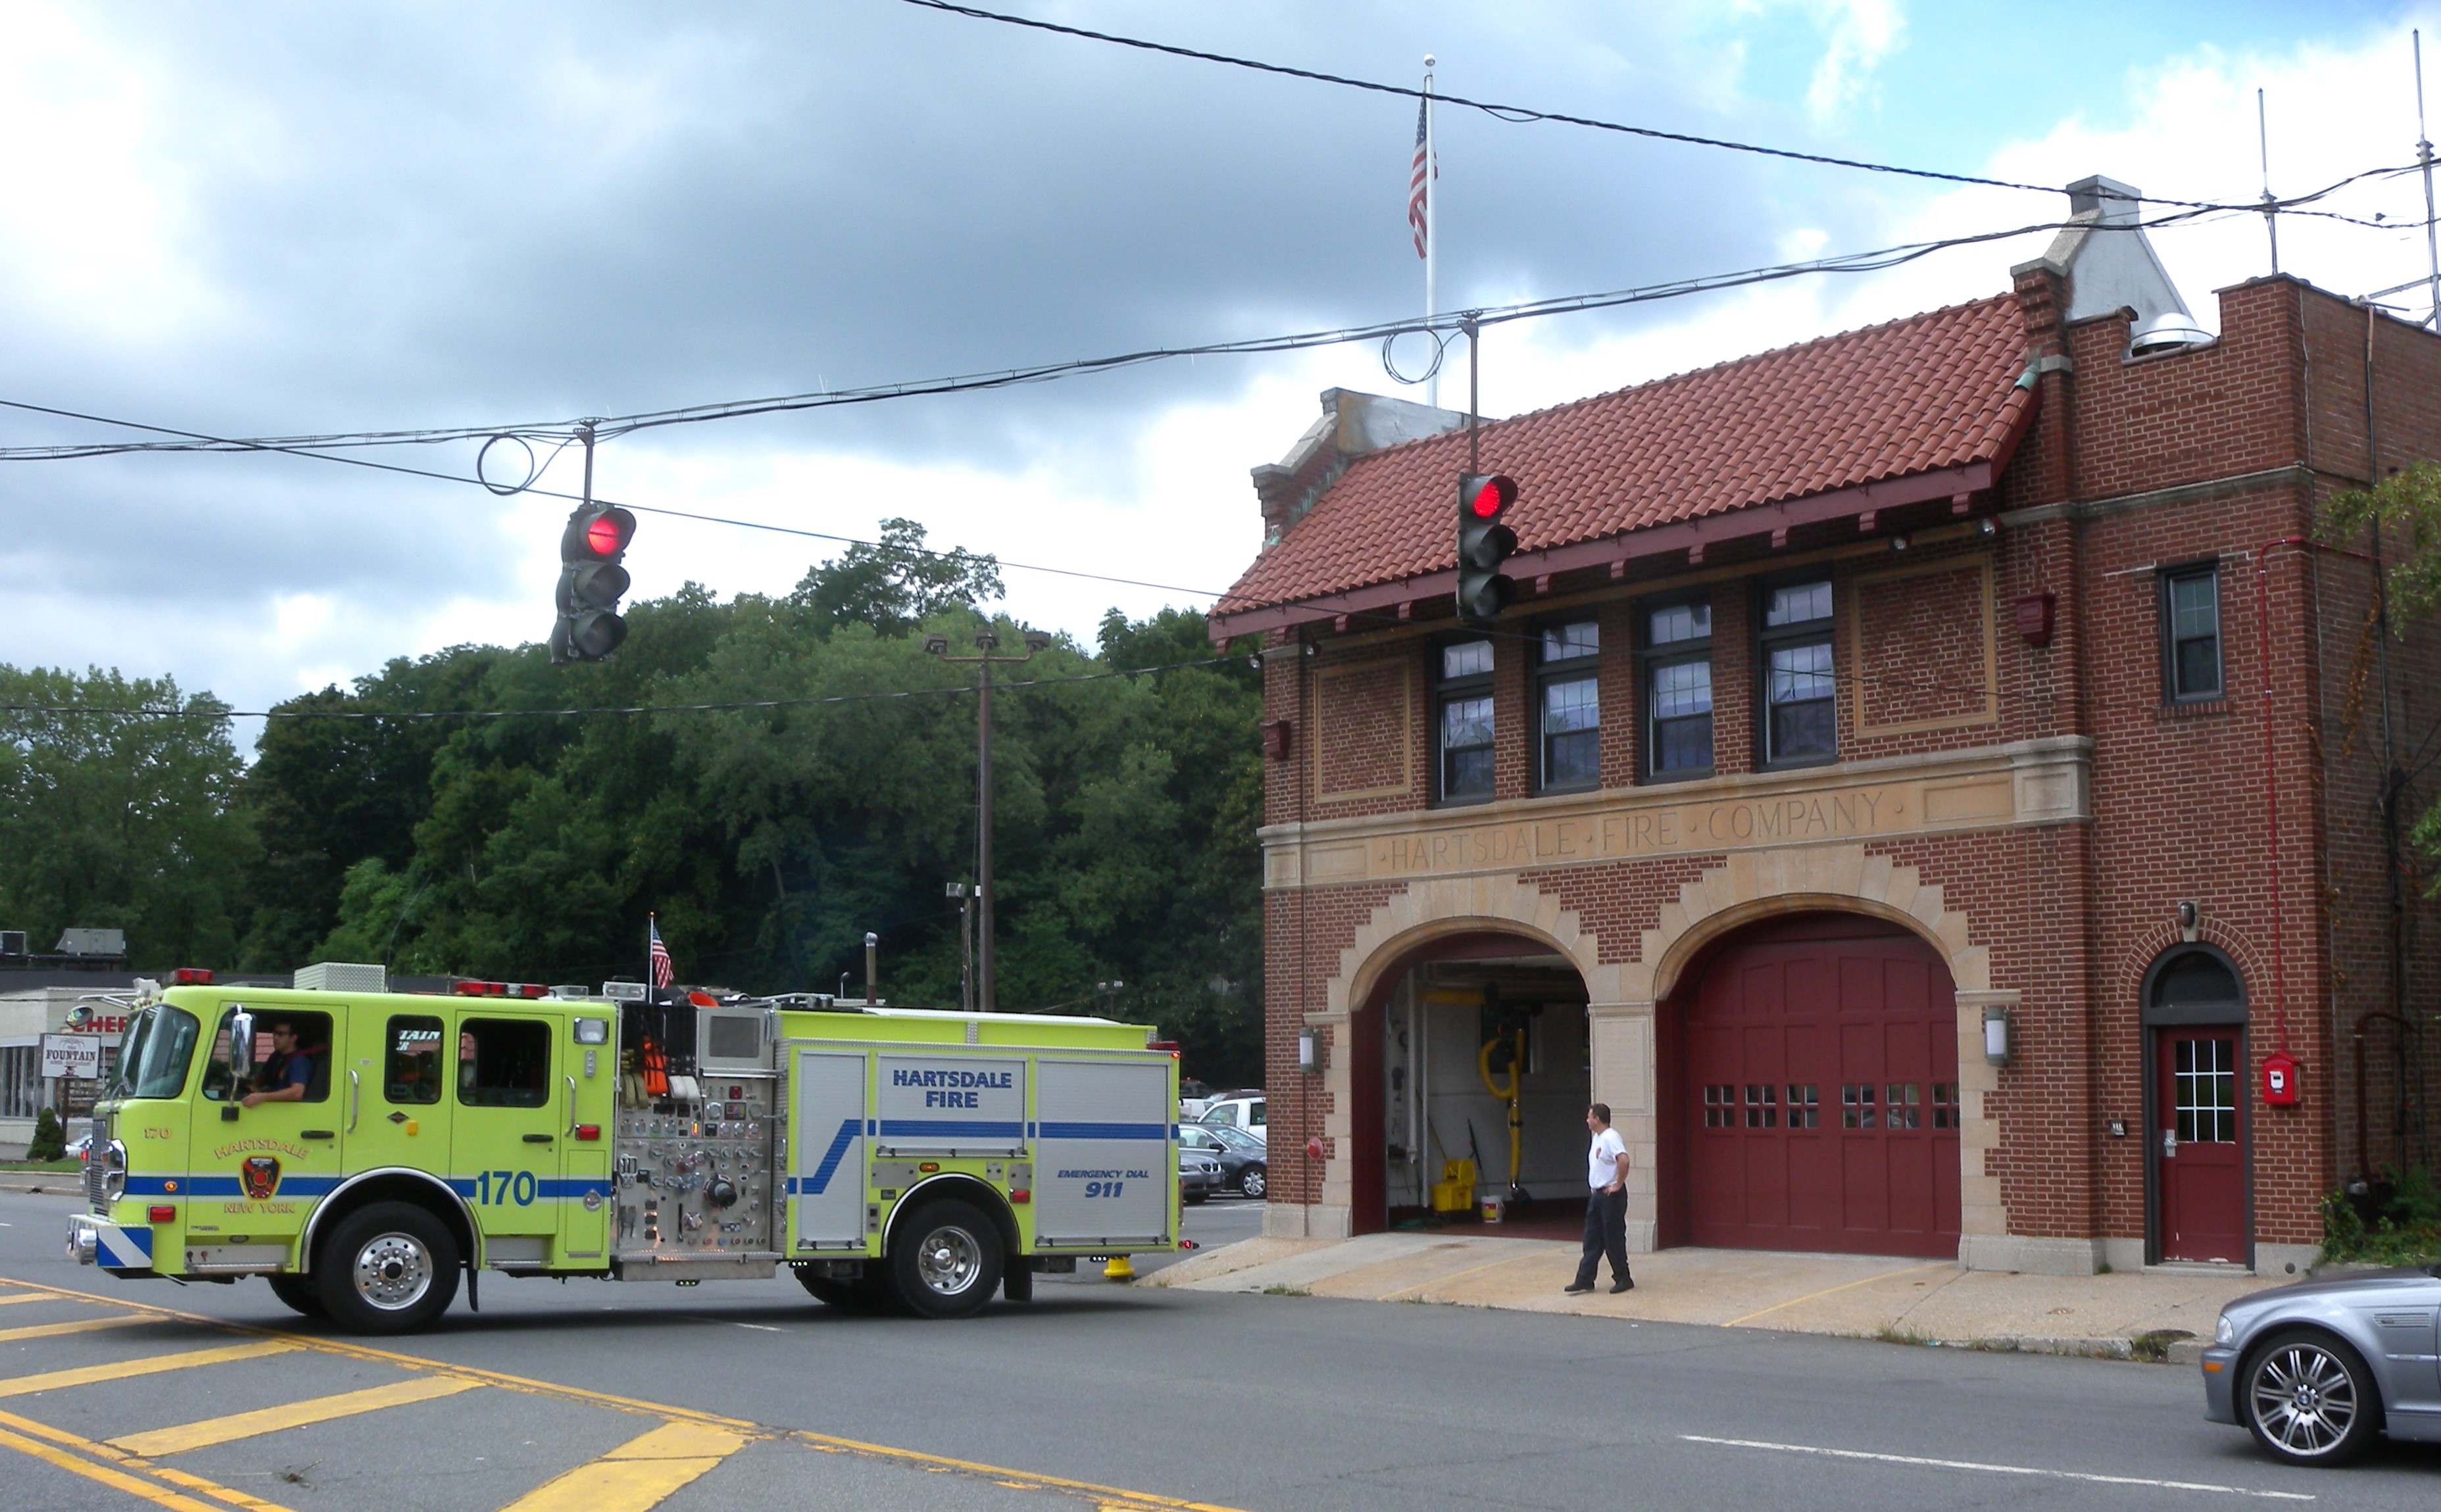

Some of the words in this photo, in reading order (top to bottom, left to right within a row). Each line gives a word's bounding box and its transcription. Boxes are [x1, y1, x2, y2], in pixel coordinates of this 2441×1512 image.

[1391, 821, 1577, 871] HARTSDALE
[1602, 812, 1678, 851] FIRE
[1708, 791, 1883, 841] COMPANY
[45, 1049, 96, 1061] FOUNTAIN
[893, 1069, 1012, 1088] HARTSDALE
[925, 1090, 979, 1108] FIRE
[144, 1127, 172, 1139] 170
[214, 1138, 309, 1159] HARTSDALE
[1057, 1169, 1123, 1178] EMERGENCY
[1125, 1169, 1150, 1178] DIAL
[478, 1171, 536, 1206] 170
[1085, 1181, 1123, 1198] 911
[224, 1202, 254, 1214] NEW
[259, 1202, 295, 1214] YORK
